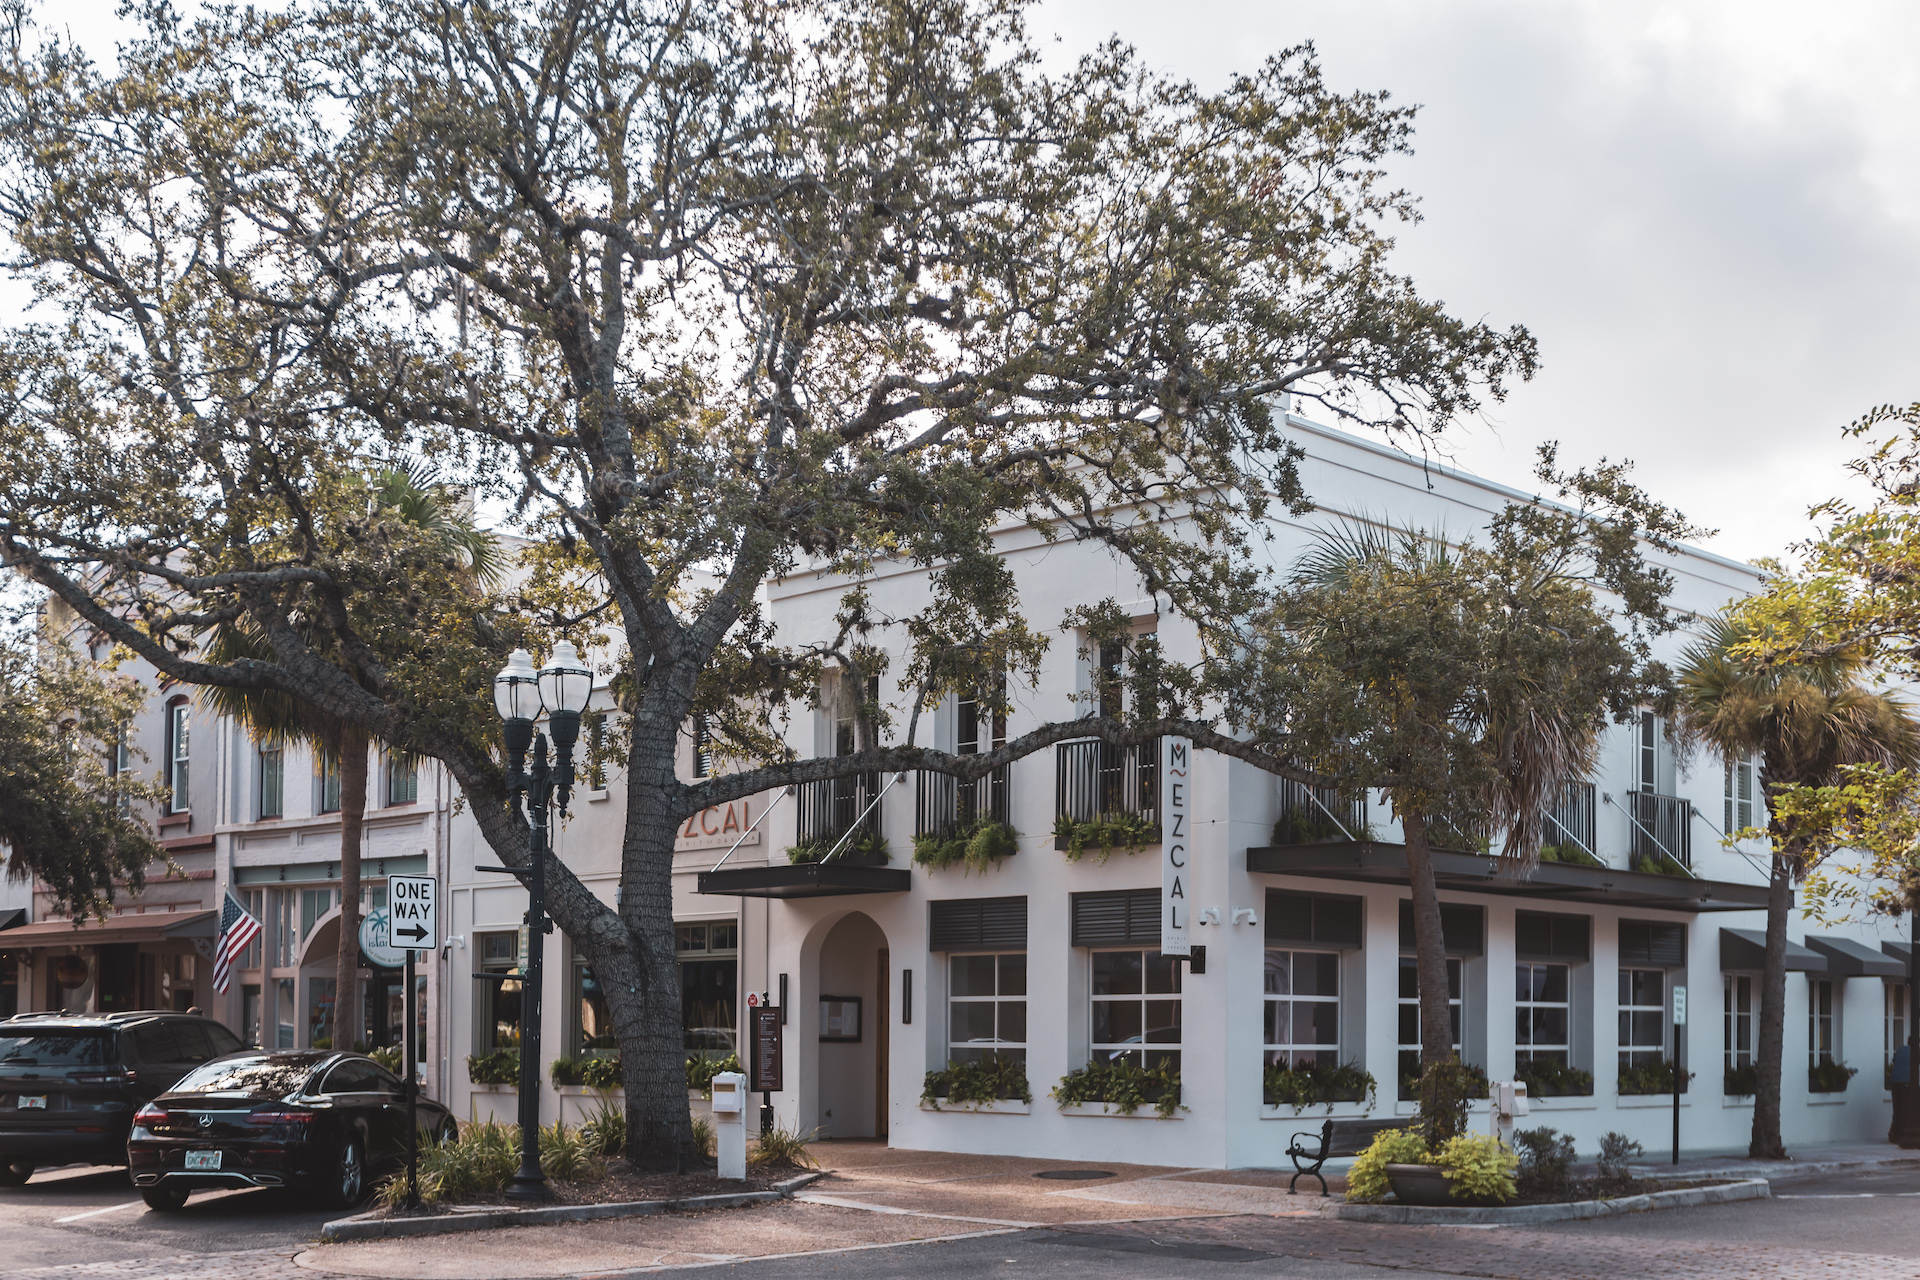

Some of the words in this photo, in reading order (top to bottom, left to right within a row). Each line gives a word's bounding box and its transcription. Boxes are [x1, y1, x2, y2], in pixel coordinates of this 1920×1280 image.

[676, 801, 757, 838] ZCAL
[1170, 743, 1187, 929] MEZCAL
[396, 882, 430, 899] ONE
[394, 902, 431, 920] WAY
